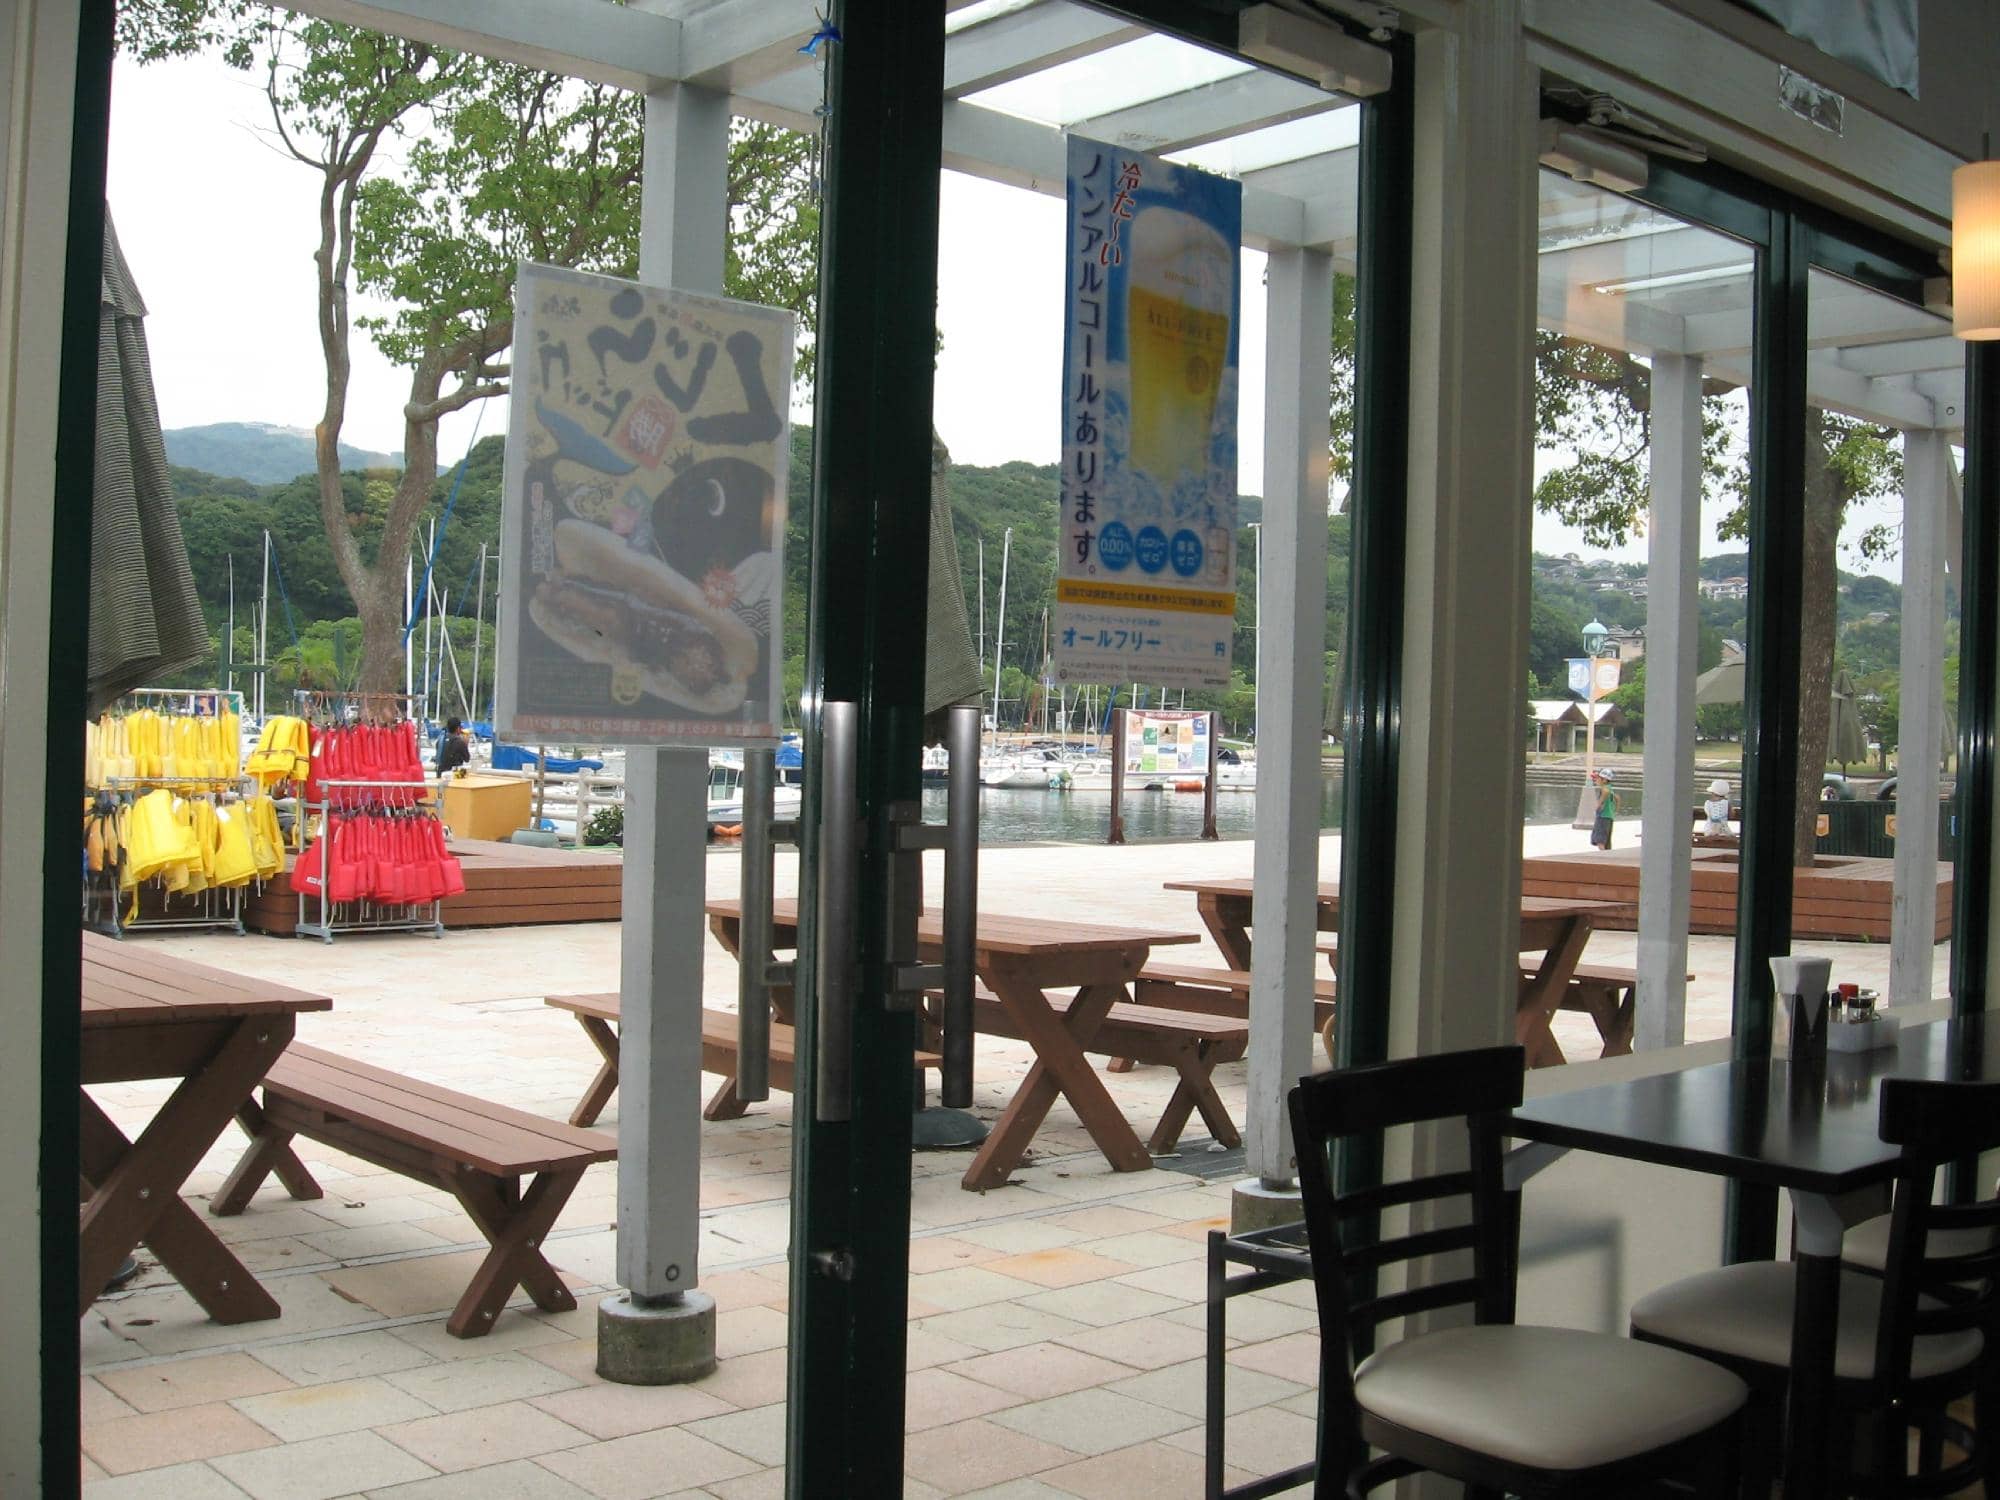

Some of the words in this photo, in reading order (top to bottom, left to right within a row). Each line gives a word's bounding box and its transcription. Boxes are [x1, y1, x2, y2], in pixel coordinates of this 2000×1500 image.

[1073, 153, 1104, 575] ノンアルコールあります。
[1063, 627, 1161, 652] オールフリー
